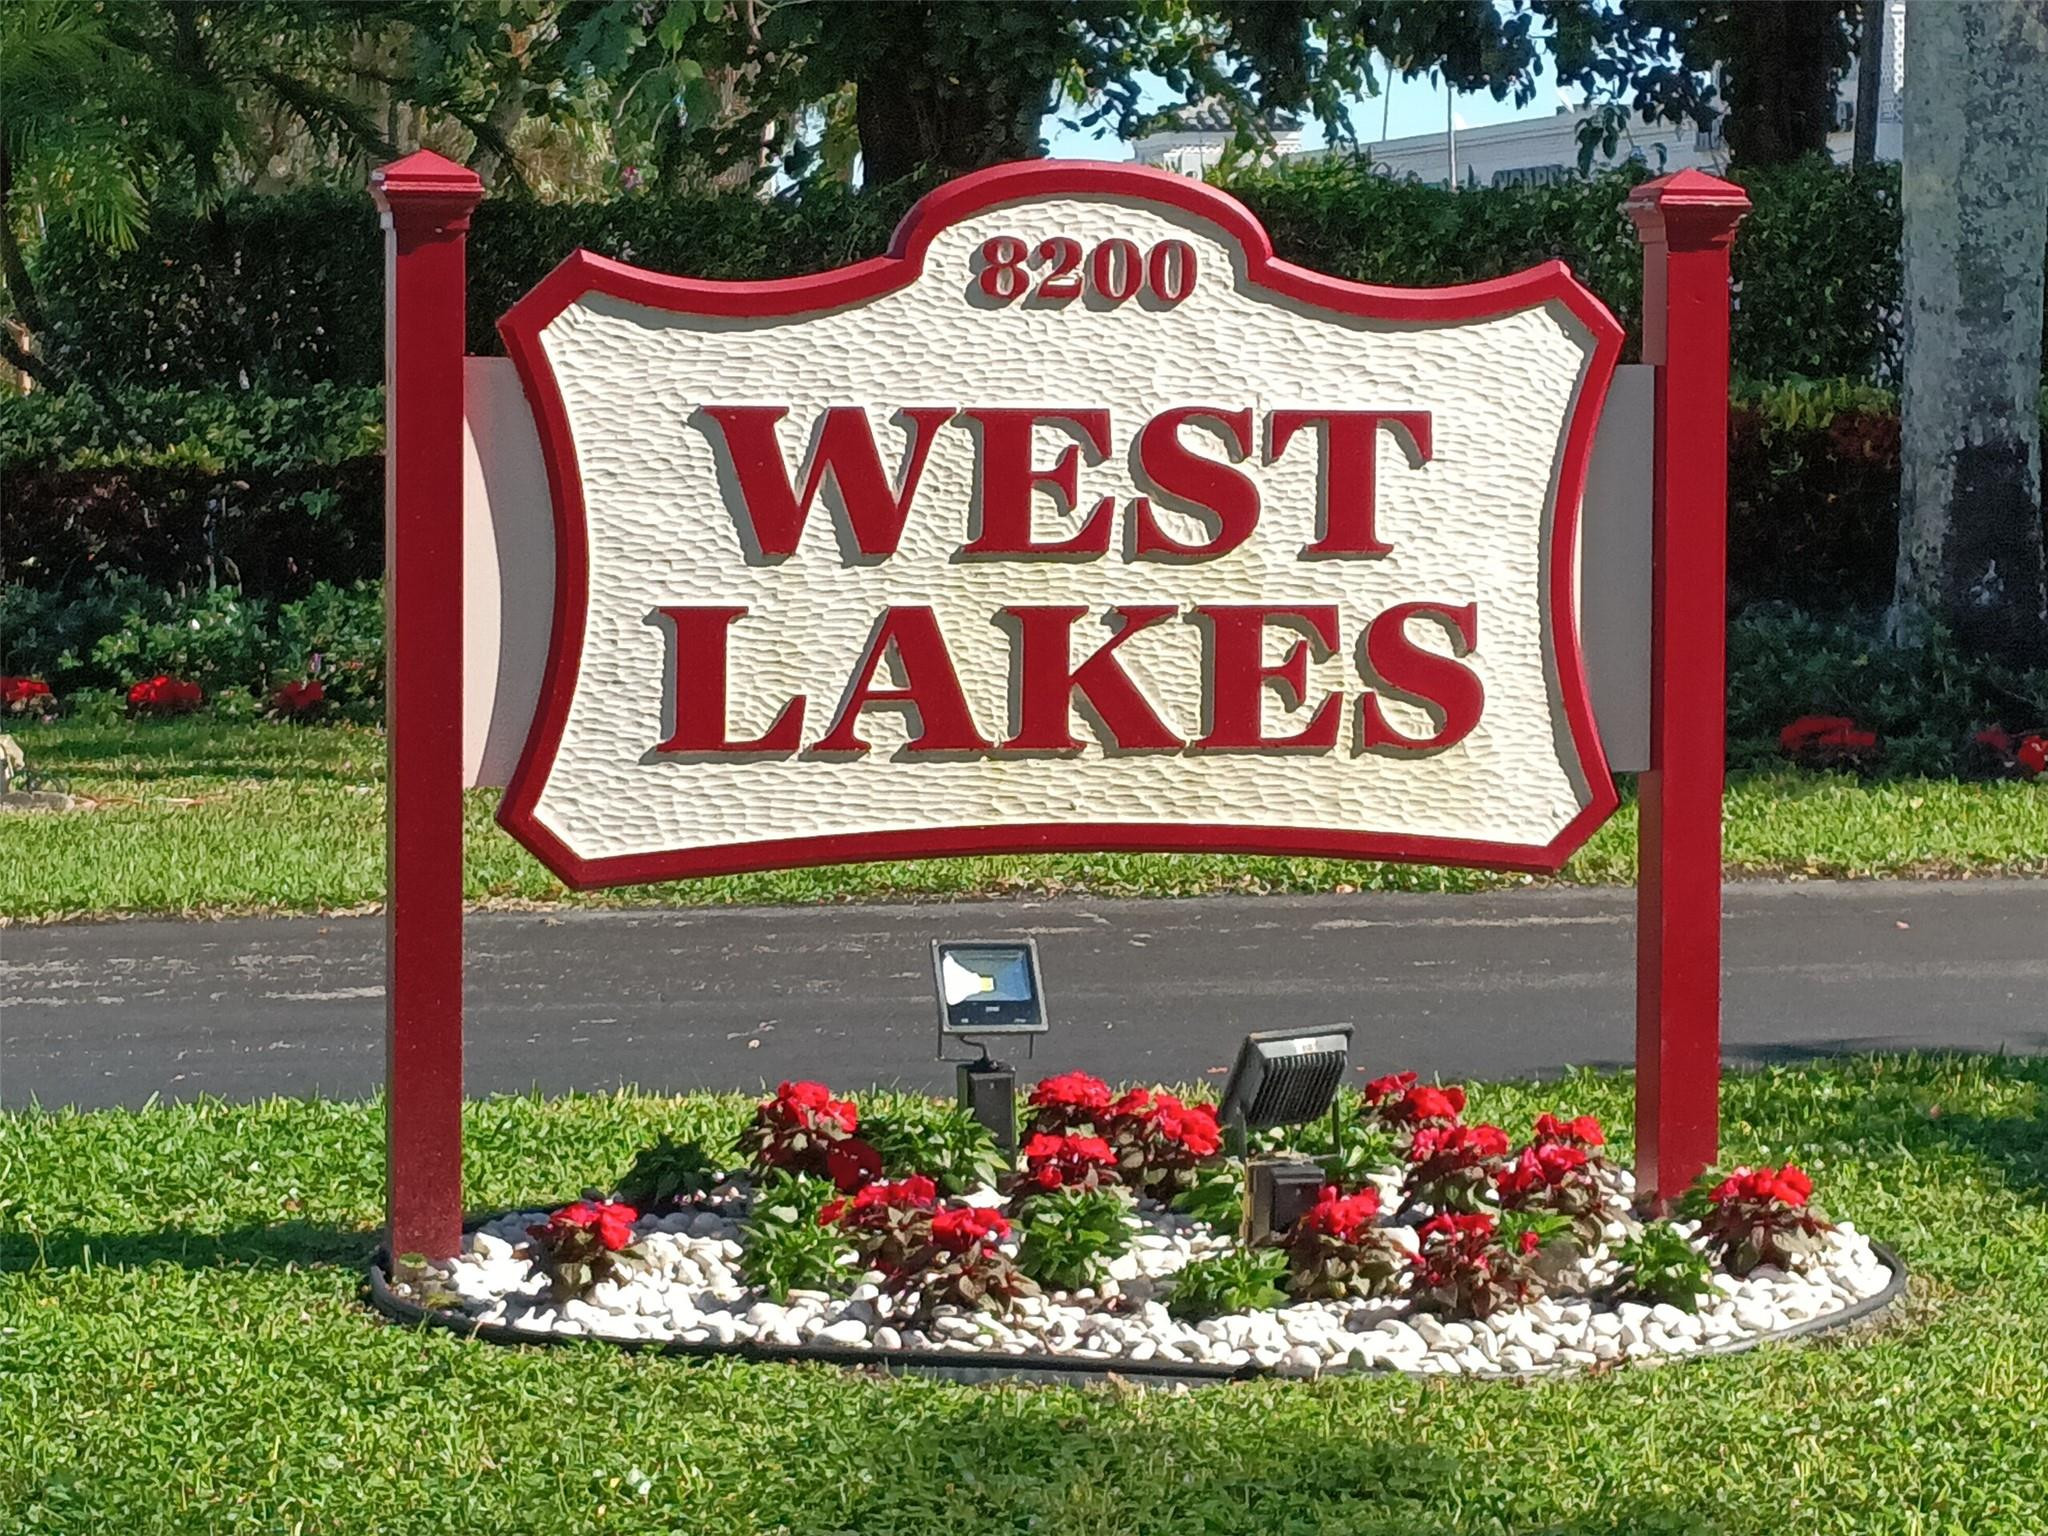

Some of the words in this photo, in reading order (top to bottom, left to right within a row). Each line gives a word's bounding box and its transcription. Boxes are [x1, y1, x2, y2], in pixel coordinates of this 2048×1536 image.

[975, 236, 1197, 303] 8200
[697, 406, 1433, 558] WEST
[652, 602, 1485, 754] LAKES
